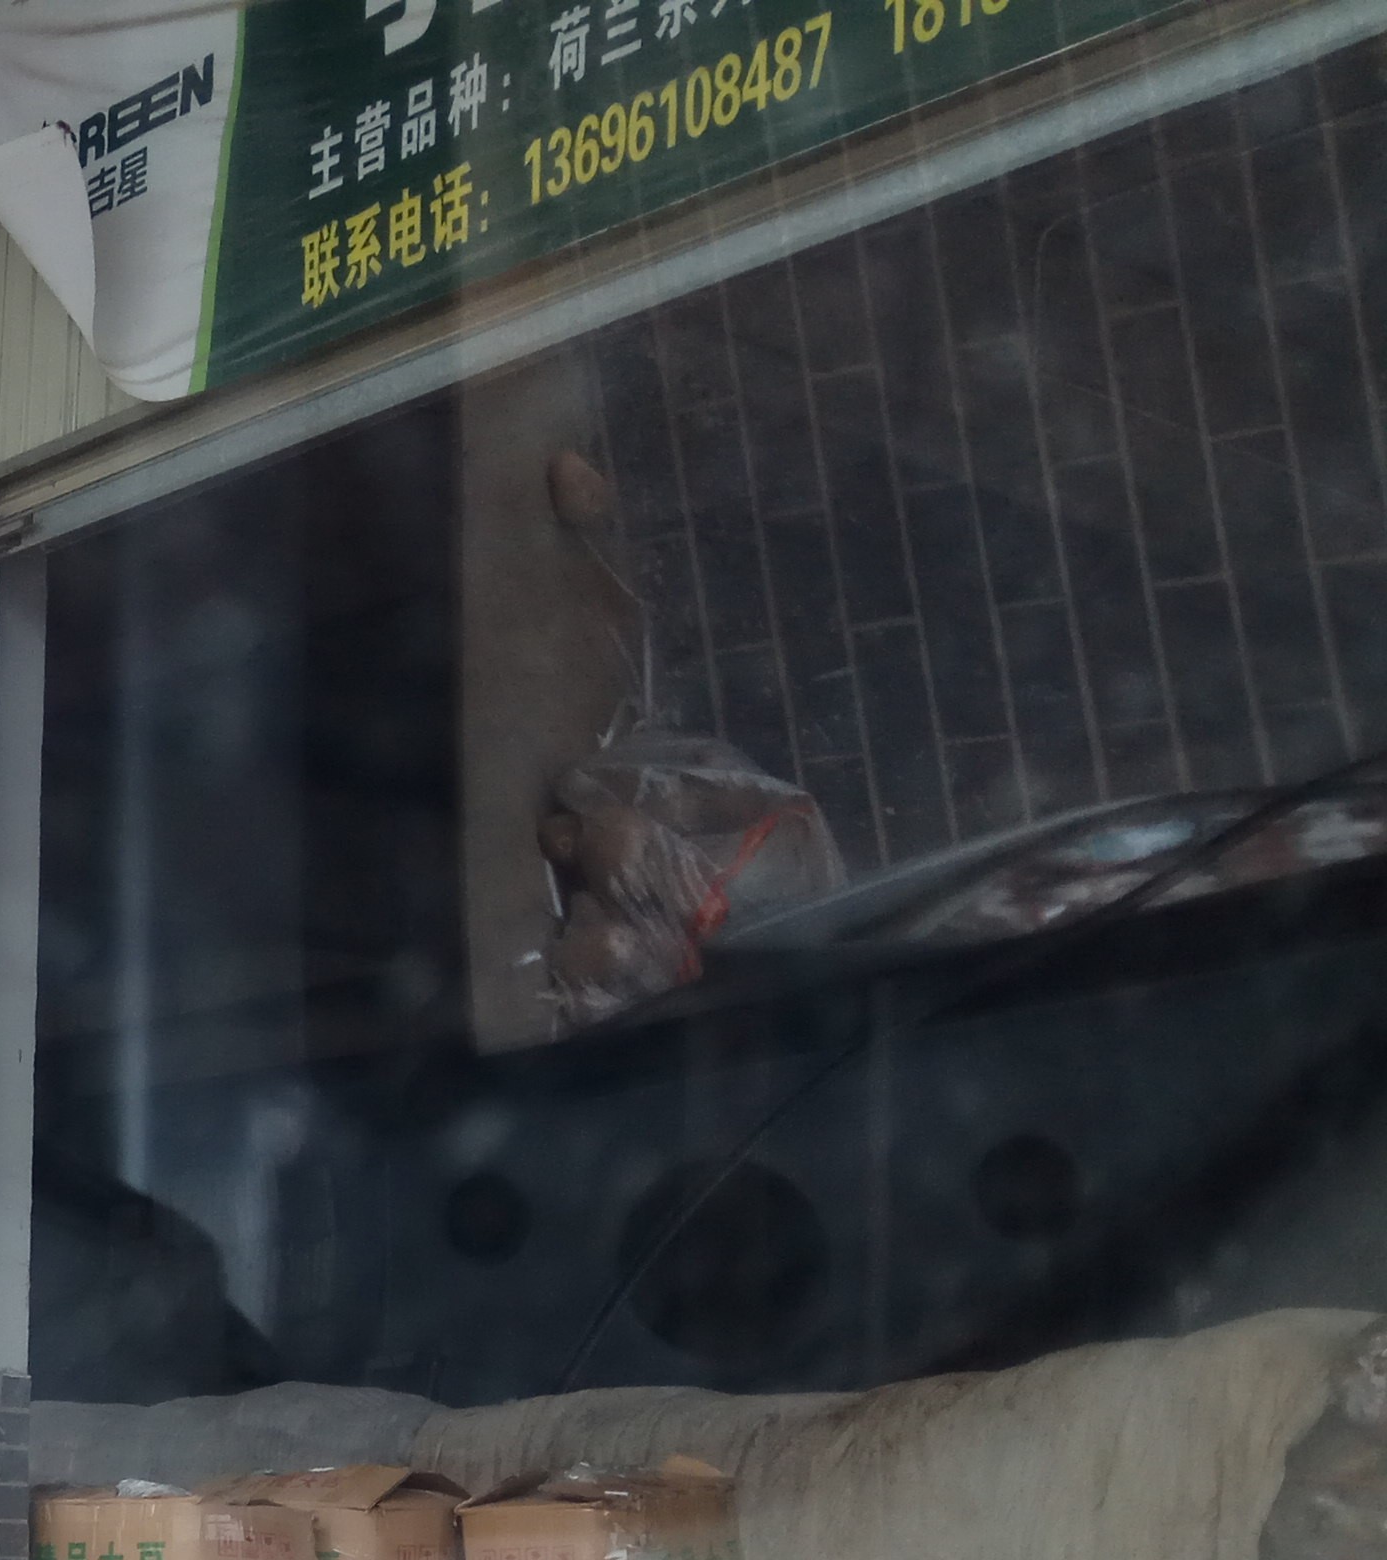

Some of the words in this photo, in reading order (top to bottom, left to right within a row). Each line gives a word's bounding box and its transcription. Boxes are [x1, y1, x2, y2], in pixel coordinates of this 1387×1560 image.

[79, 54, 214, 169] REEN
[308, 0, 749, 200] 主营品种：荷兰
[87, 146, 148, 220] 吉星
